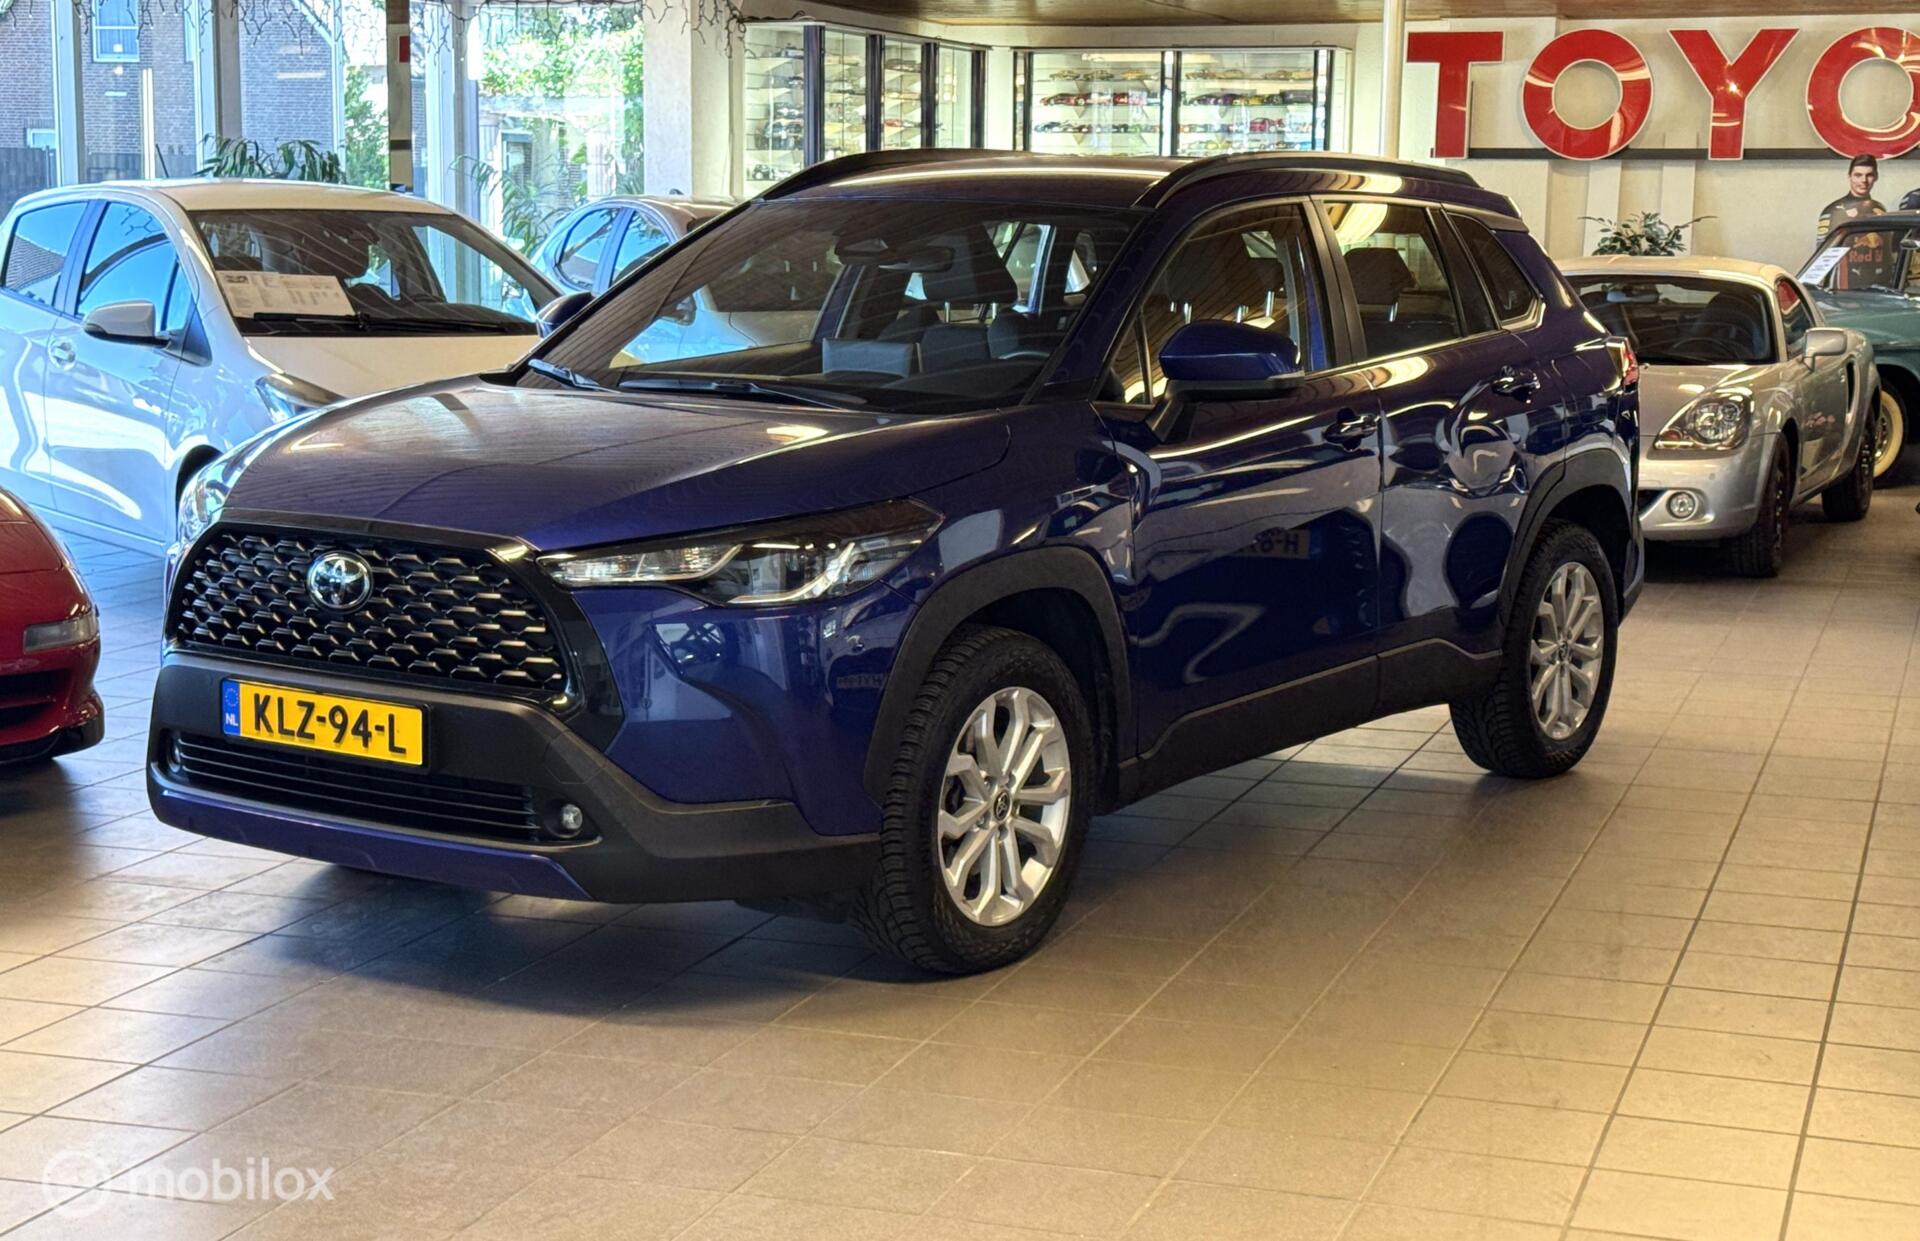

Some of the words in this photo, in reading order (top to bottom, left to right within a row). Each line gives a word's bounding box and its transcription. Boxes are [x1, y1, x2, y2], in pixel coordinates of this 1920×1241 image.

[1406, 26, 1920, 160] TOYO
[1849, 248, 1872, 263] Red
[225, 713, 238, 726] NL
[254, 693, 407, 755] KLZ-94-L
